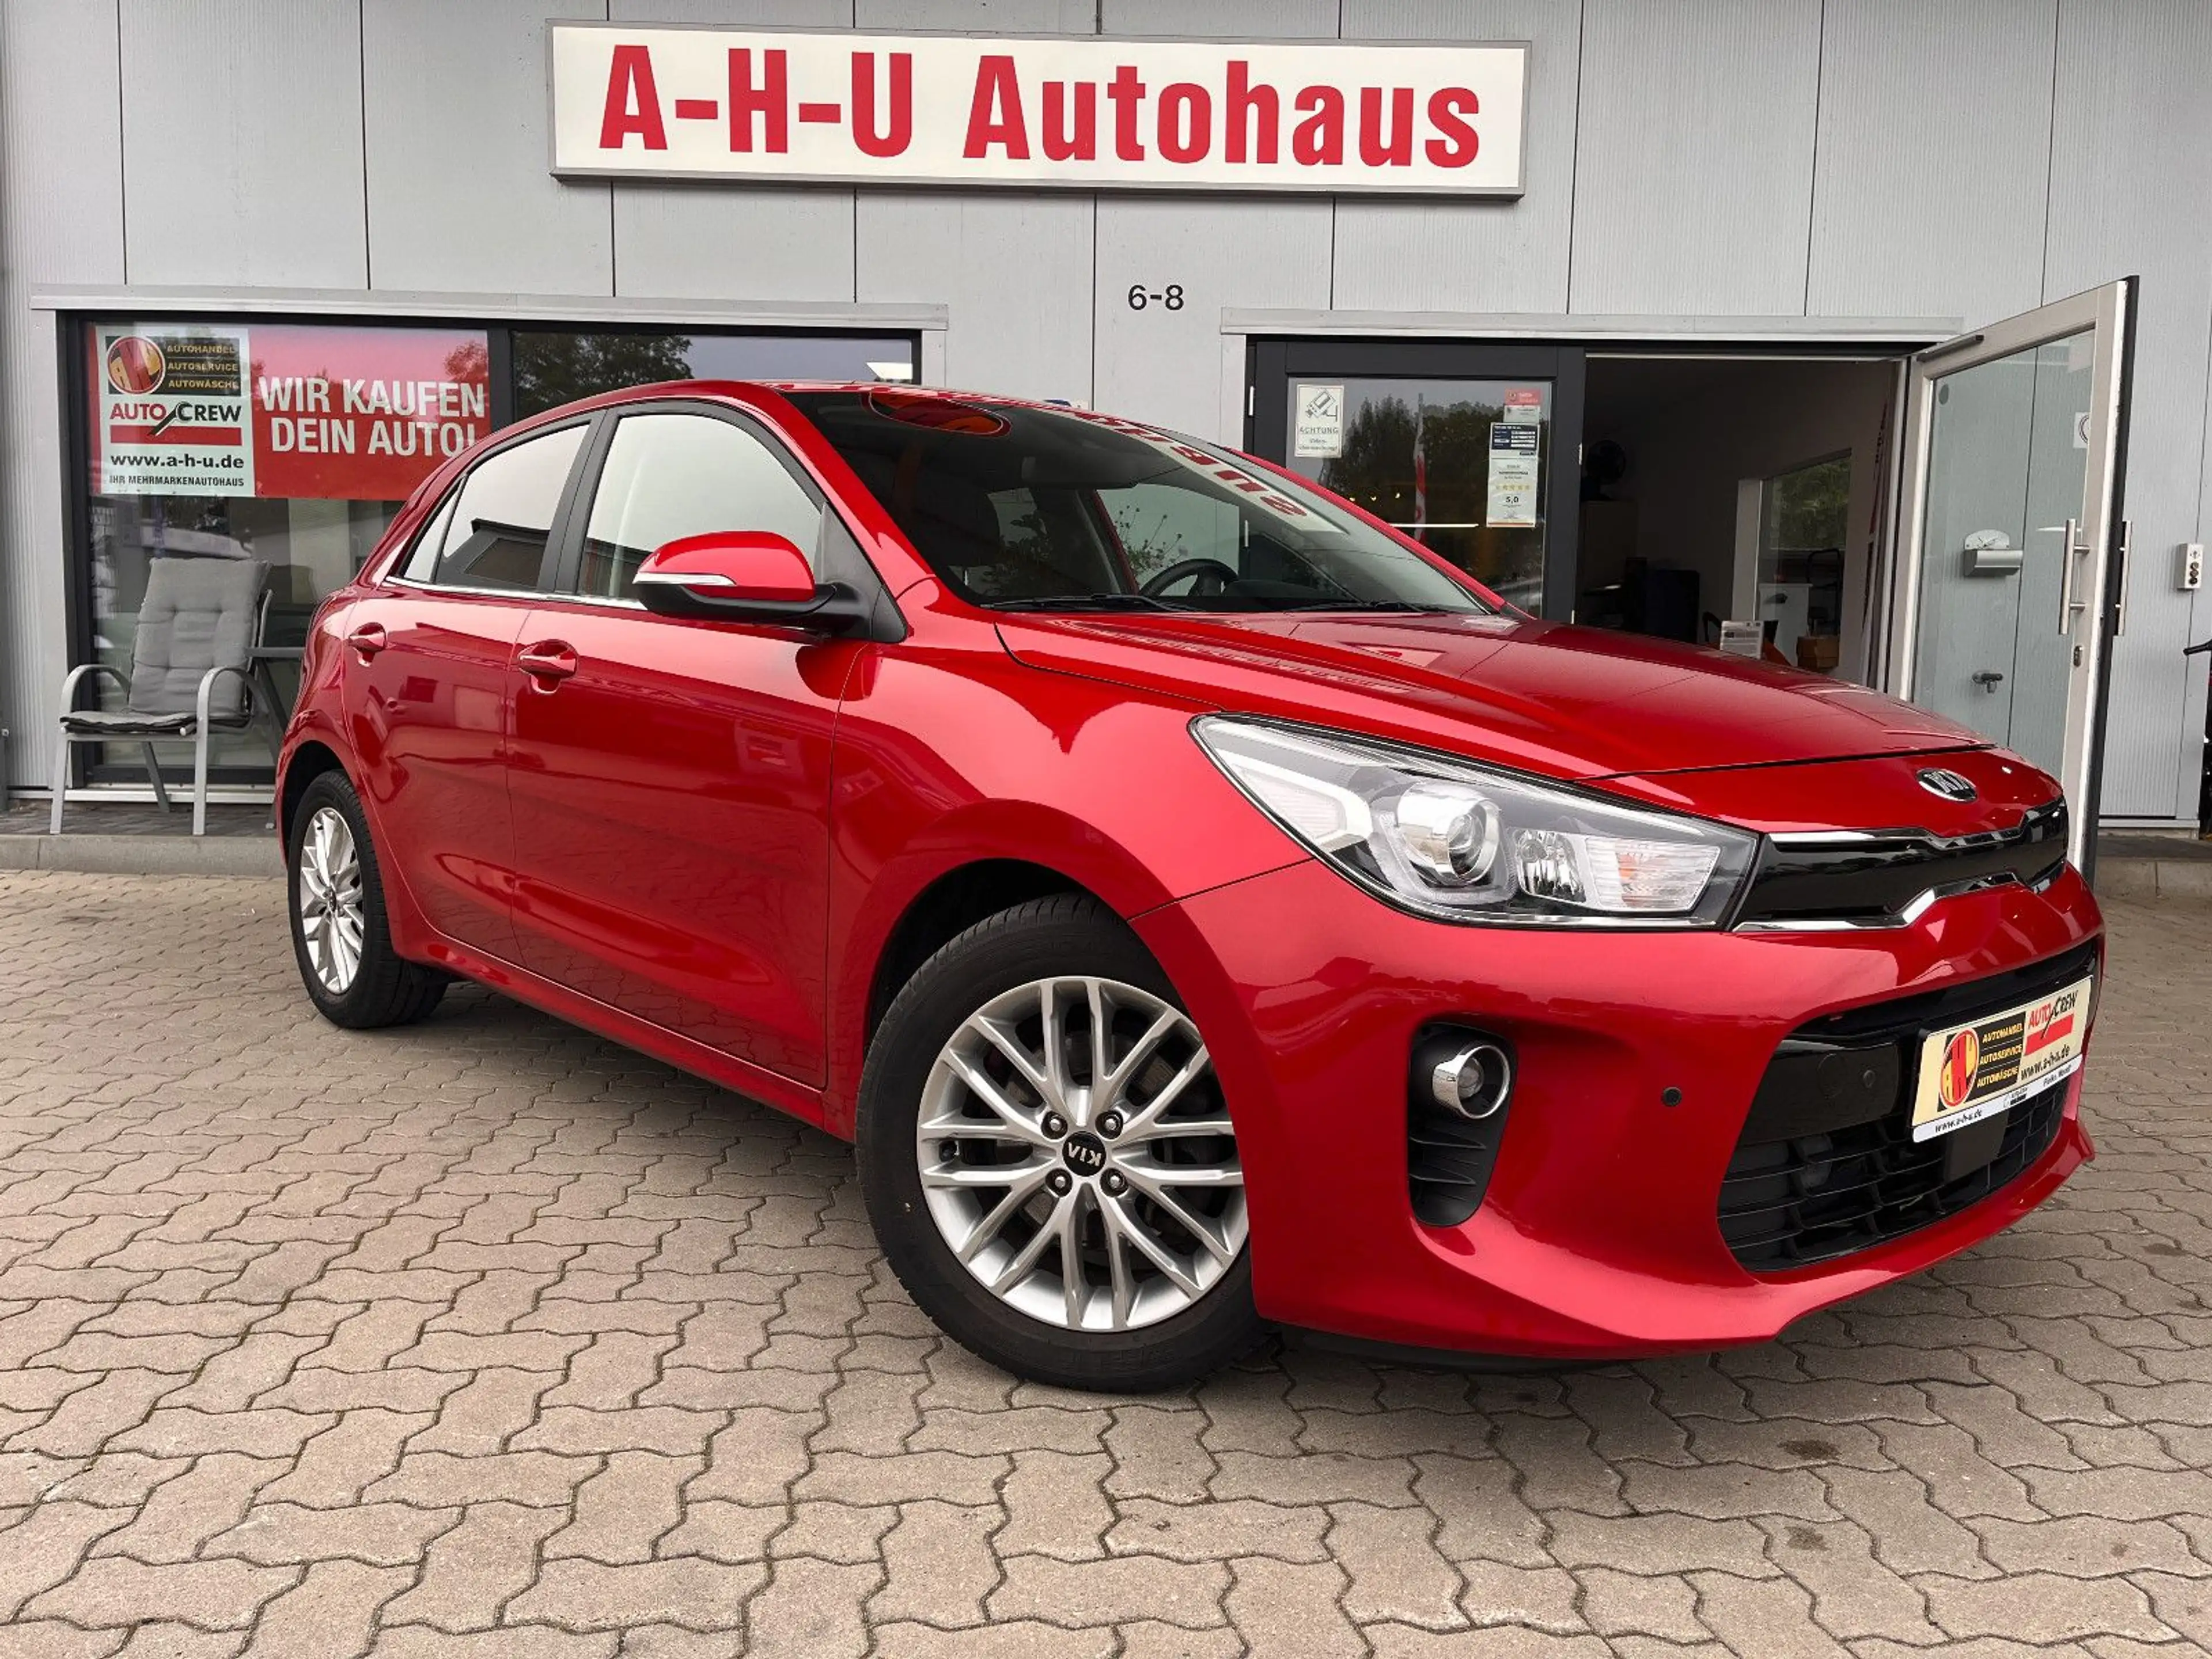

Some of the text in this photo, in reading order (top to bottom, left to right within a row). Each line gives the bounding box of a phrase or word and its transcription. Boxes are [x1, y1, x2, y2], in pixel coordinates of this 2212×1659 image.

[599, 44, 1479, 168] A-H-U Autohaus
[1128, 285, 1184, 310] 6-8
[166, 344, 236, 354] AUTOHANDEL
[167, 362, 238, 372] AUTOSERVICE
[258, 376, 486, 418] WIR KAUFEN
[271, 418, 476, 457] DEIN AUTO!
[110, 453, 245, 468] www.a-h-u.de
[109, 475, 244, 487] IHR MEHRMARKENAUTOHAUS
[1982, 1022, 2024, 1044] AUTOHANDEL
[1979, 1043, 2023, 1066] AUTOSERVICE
[2021, 1043, 2071, 1081] www.a-h-u.de
[1068, 1142, 1102, 1167] KIA
